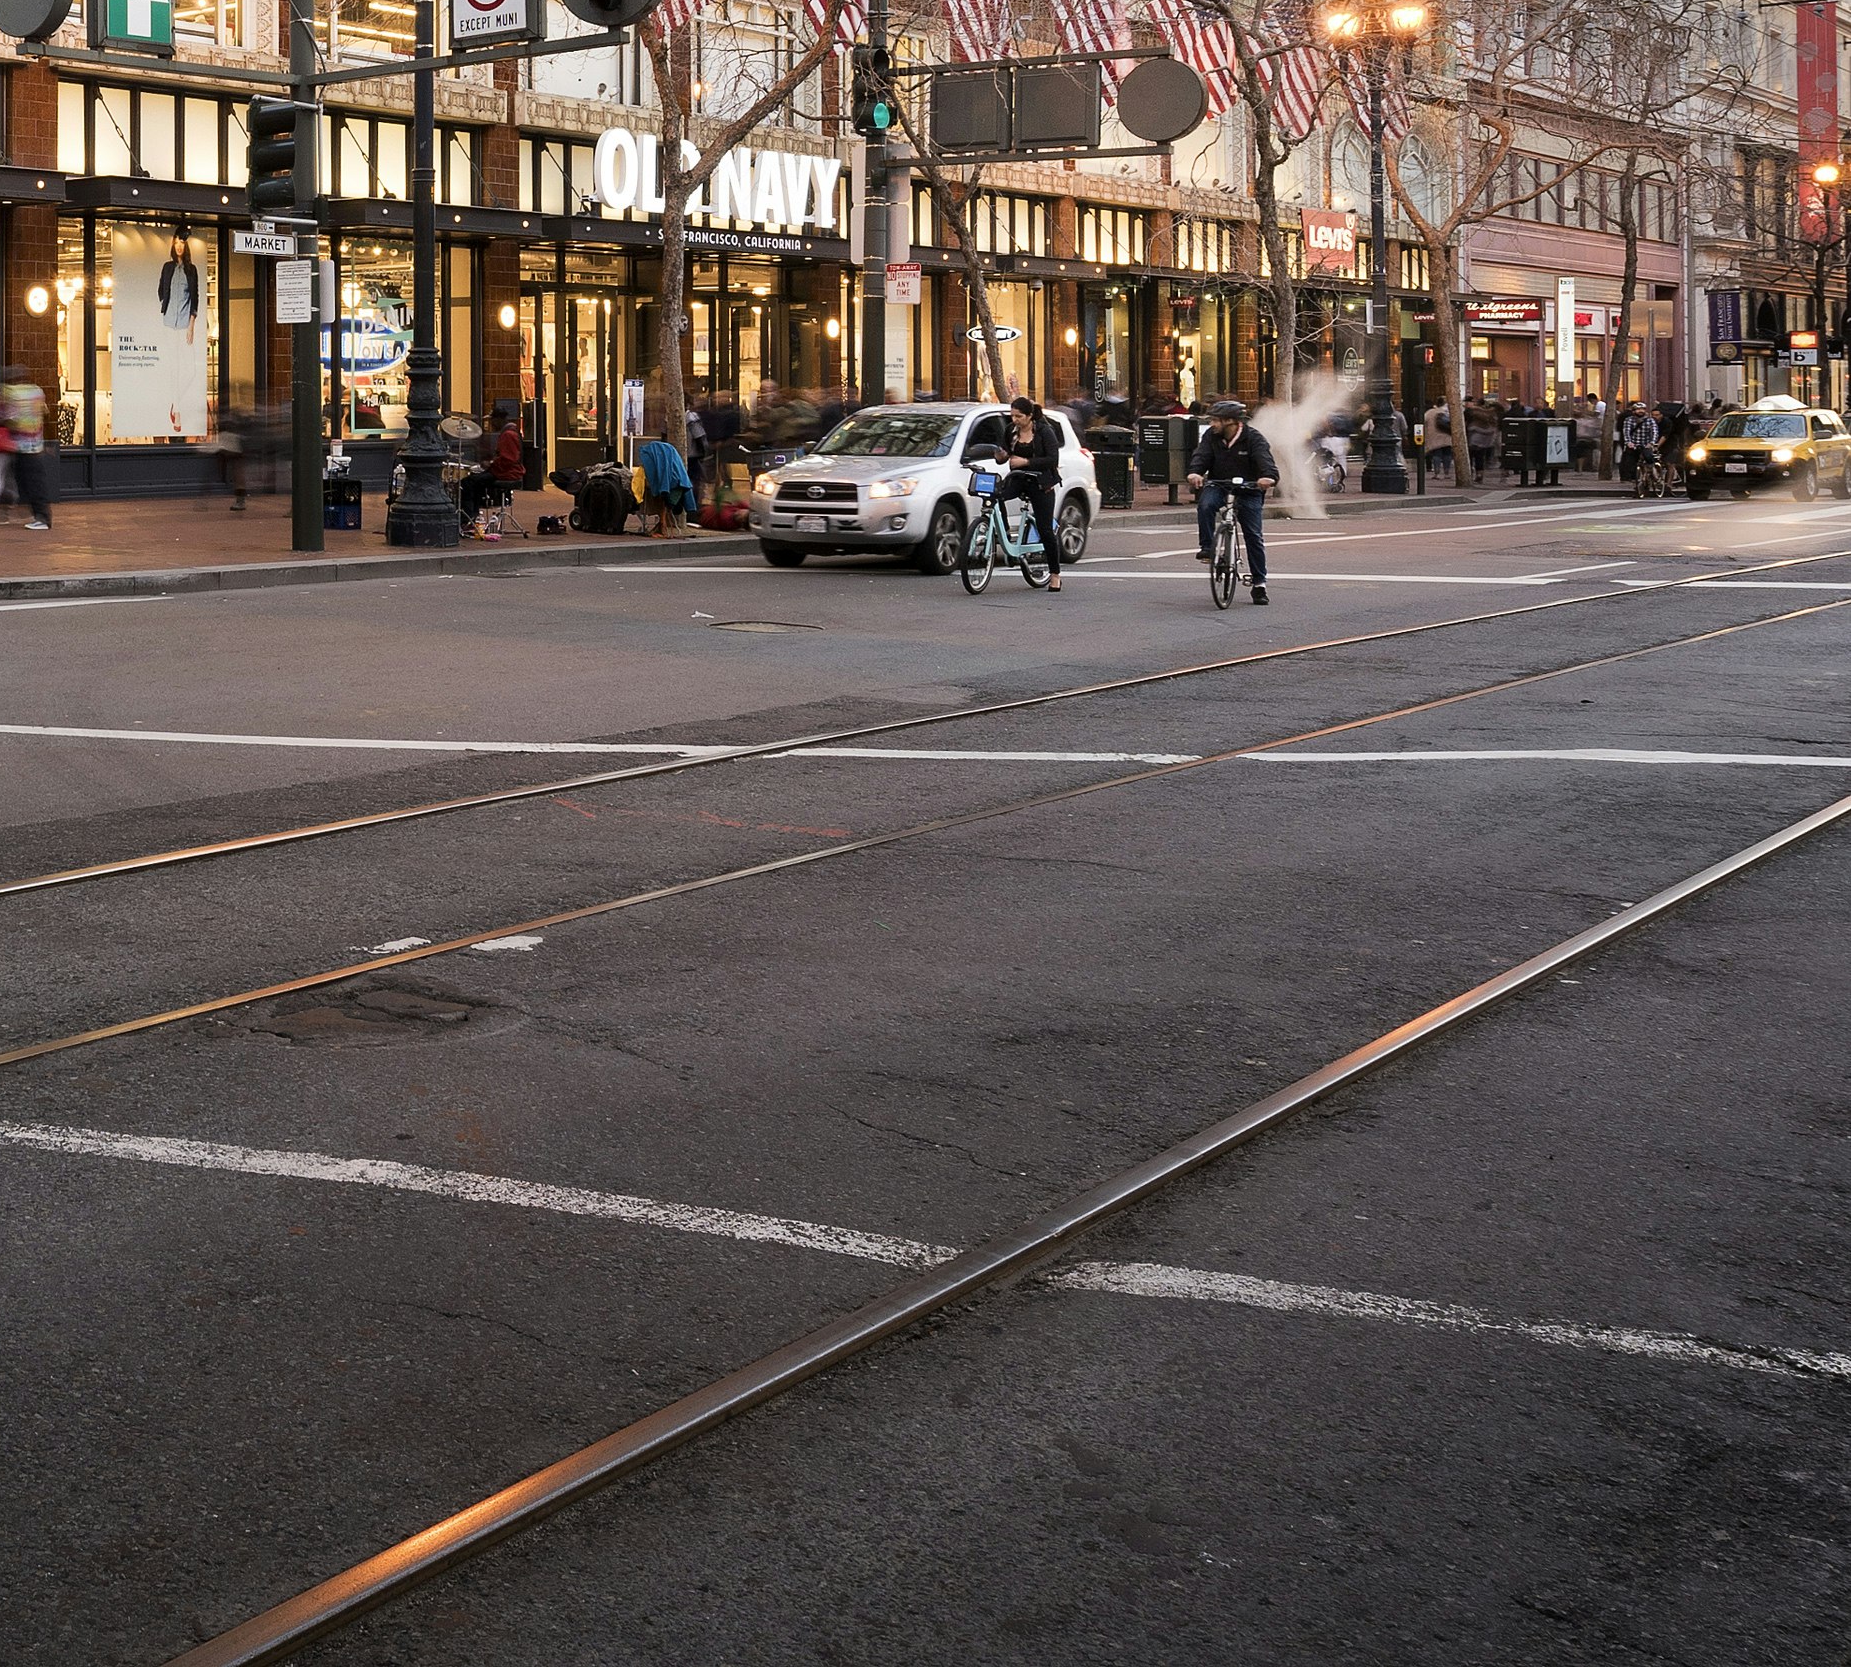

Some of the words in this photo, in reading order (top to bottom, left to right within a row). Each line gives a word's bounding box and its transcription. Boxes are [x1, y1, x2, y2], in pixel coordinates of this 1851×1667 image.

[460, 15, 491, 33] EXCEPT
[495, 12, 518, 27] MUNI
[717, 146, 842, 229] NAVY
[244, 236, 287, 251] MARKET
[683, 230, 741, 248] FRANCISCO,
[744, 236, 801, 251] CALIFORNIA
[897, 271, 920, 279] STOPPING
